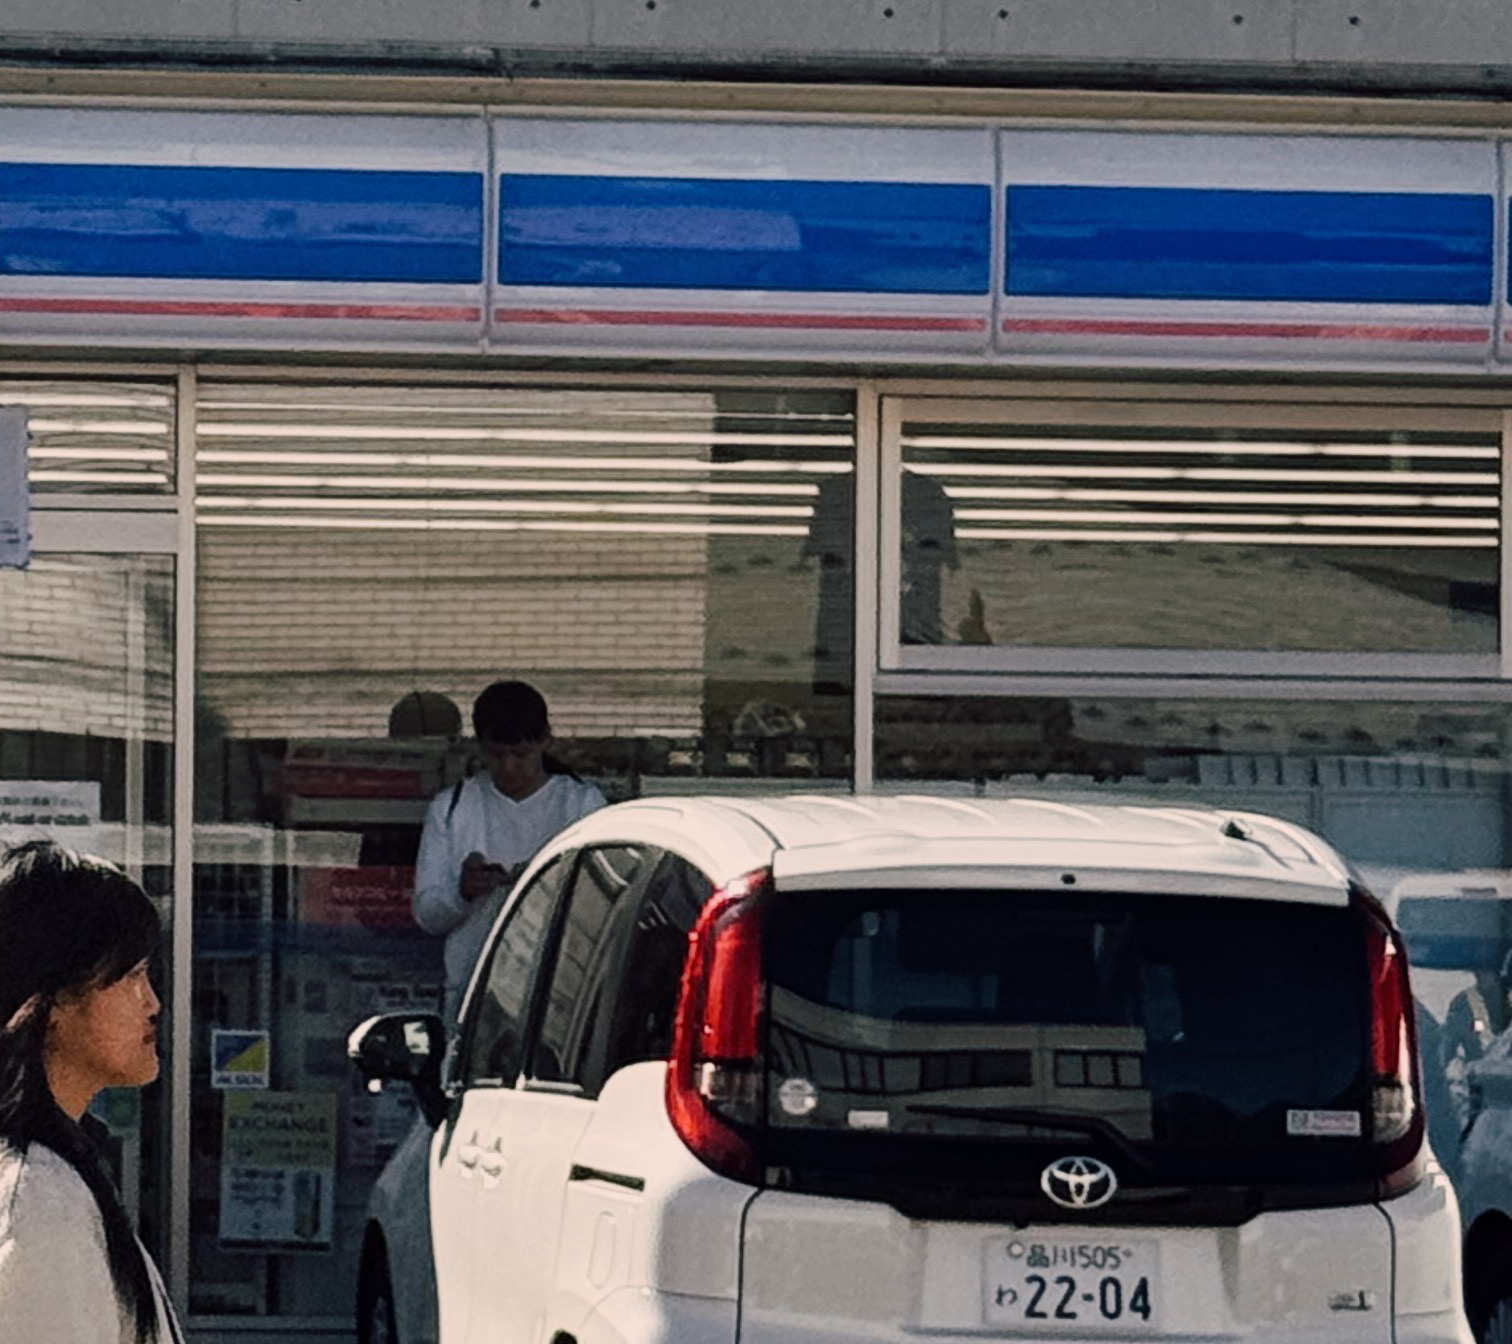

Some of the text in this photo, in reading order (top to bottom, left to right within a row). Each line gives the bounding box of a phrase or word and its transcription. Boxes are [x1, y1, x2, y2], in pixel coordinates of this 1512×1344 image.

[228, 1115, 329, 1133] EXCHANGE
[995, 1274, 1152, 1321] わ 22-04
